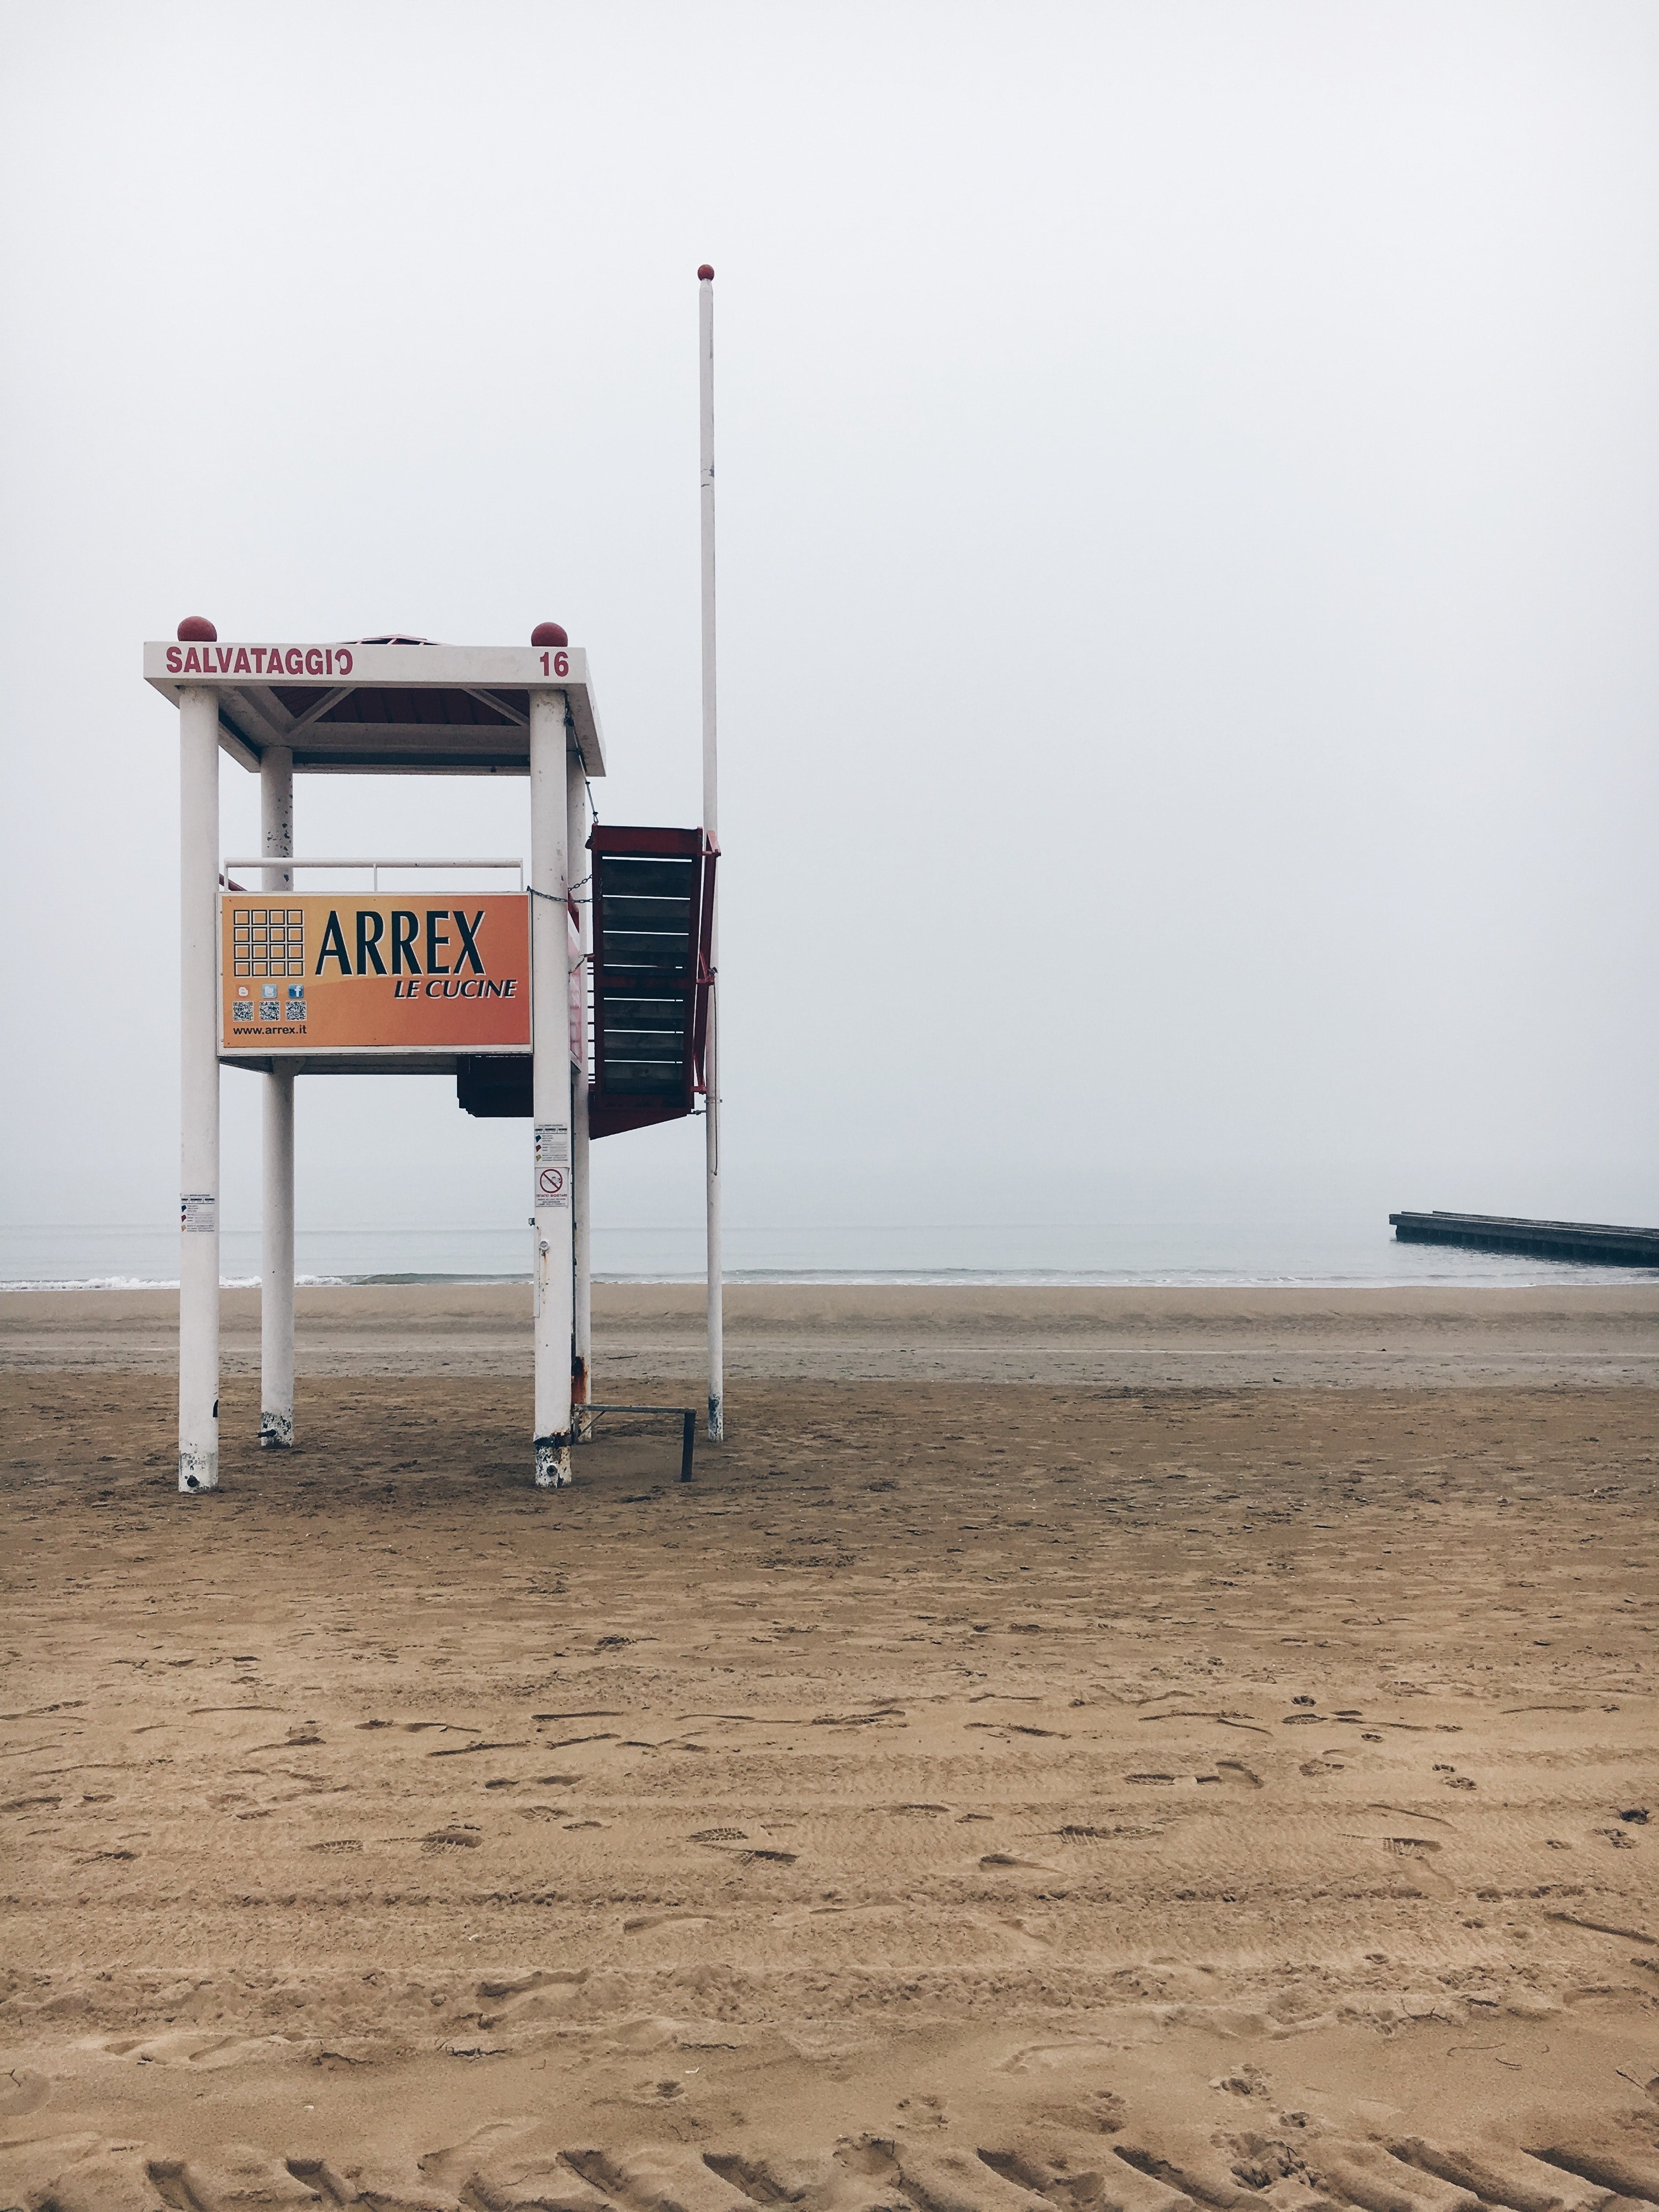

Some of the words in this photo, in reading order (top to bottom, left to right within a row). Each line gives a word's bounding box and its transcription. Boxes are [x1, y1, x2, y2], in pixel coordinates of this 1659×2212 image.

[540, 651, 569, 677] 16
[315, 910, 486, 977] ARREX
[394, 980, 421, 999] LE
[425, 979, 518, 1000] CUCINE
[233, 1024, 307, 1035] www.arrex.it
